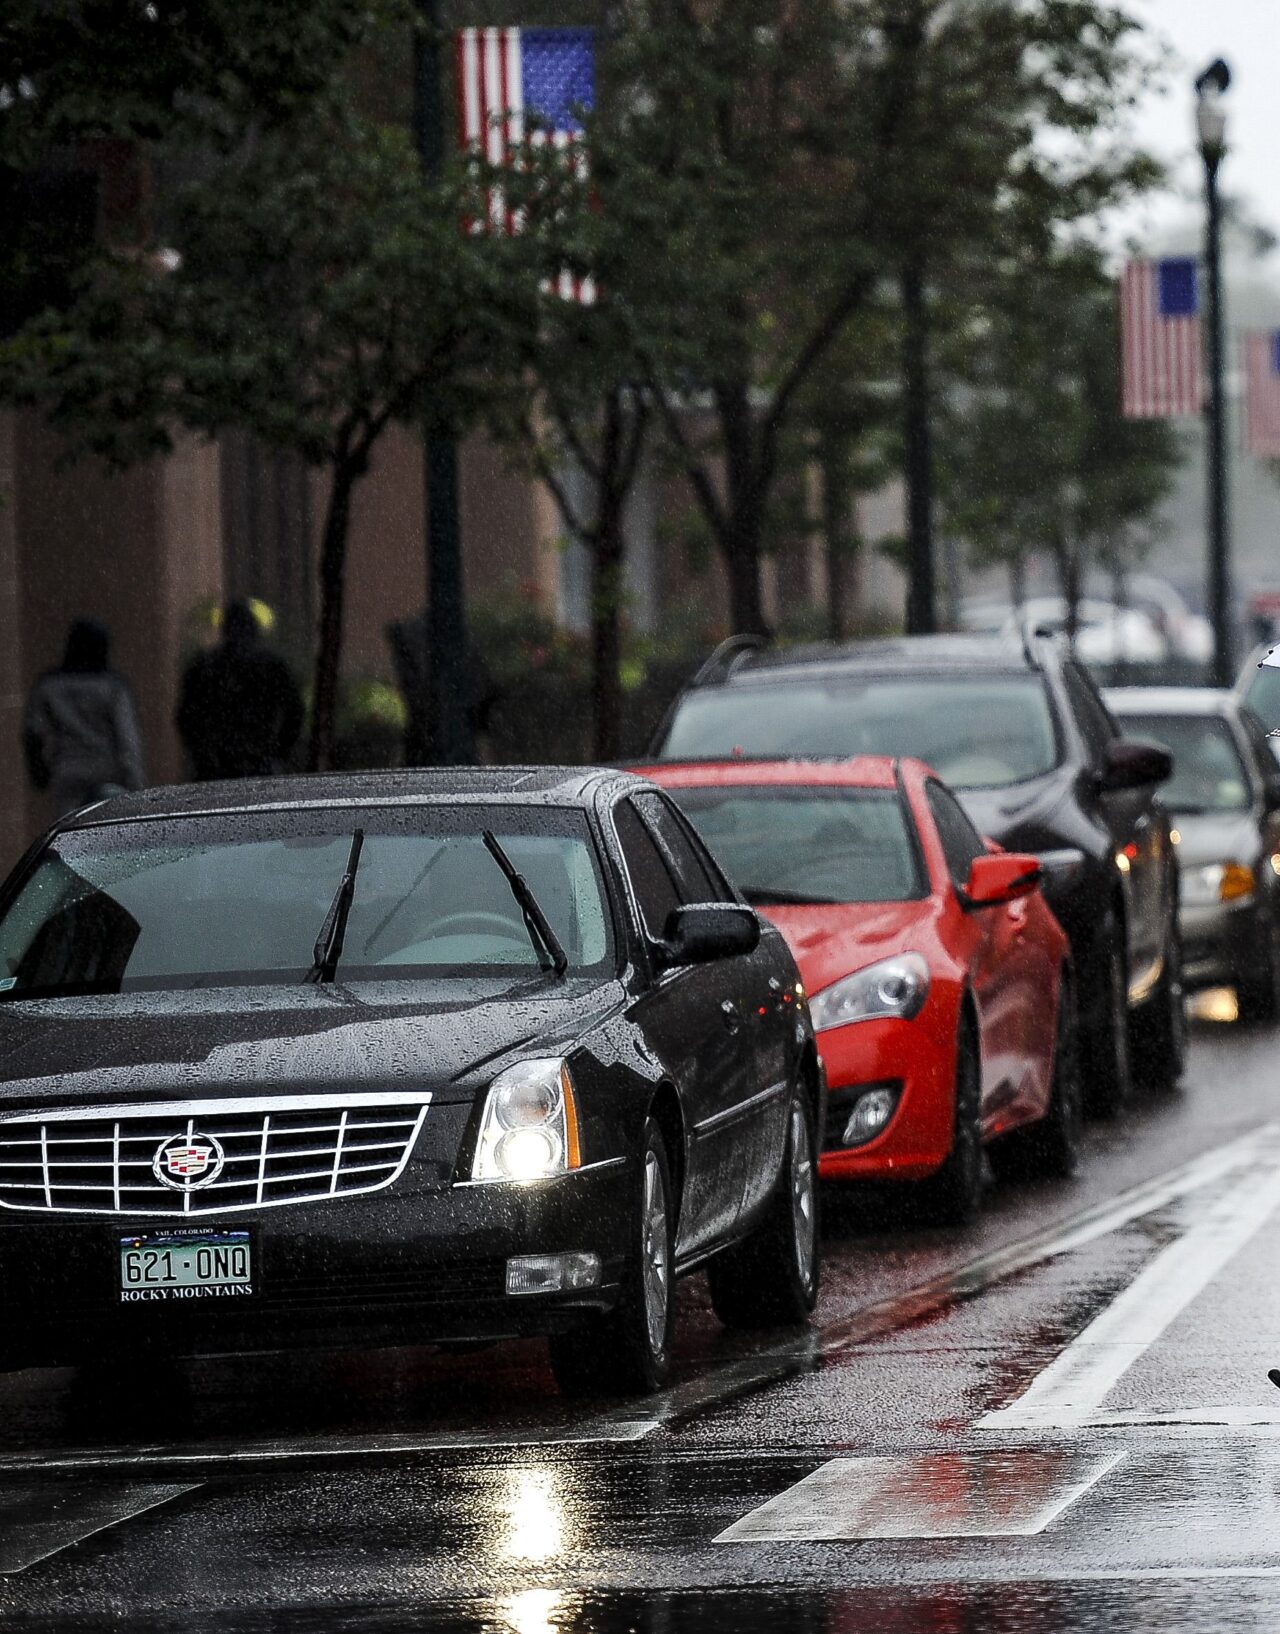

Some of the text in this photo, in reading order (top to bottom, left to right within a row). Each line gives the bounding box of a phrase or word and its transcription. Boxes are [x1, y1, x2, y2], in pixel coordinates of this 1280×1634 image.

[173, 1228, 214, 1236] COLORADO
[121, 1284, 253, 1302] ROCKY MOUNTAINS
